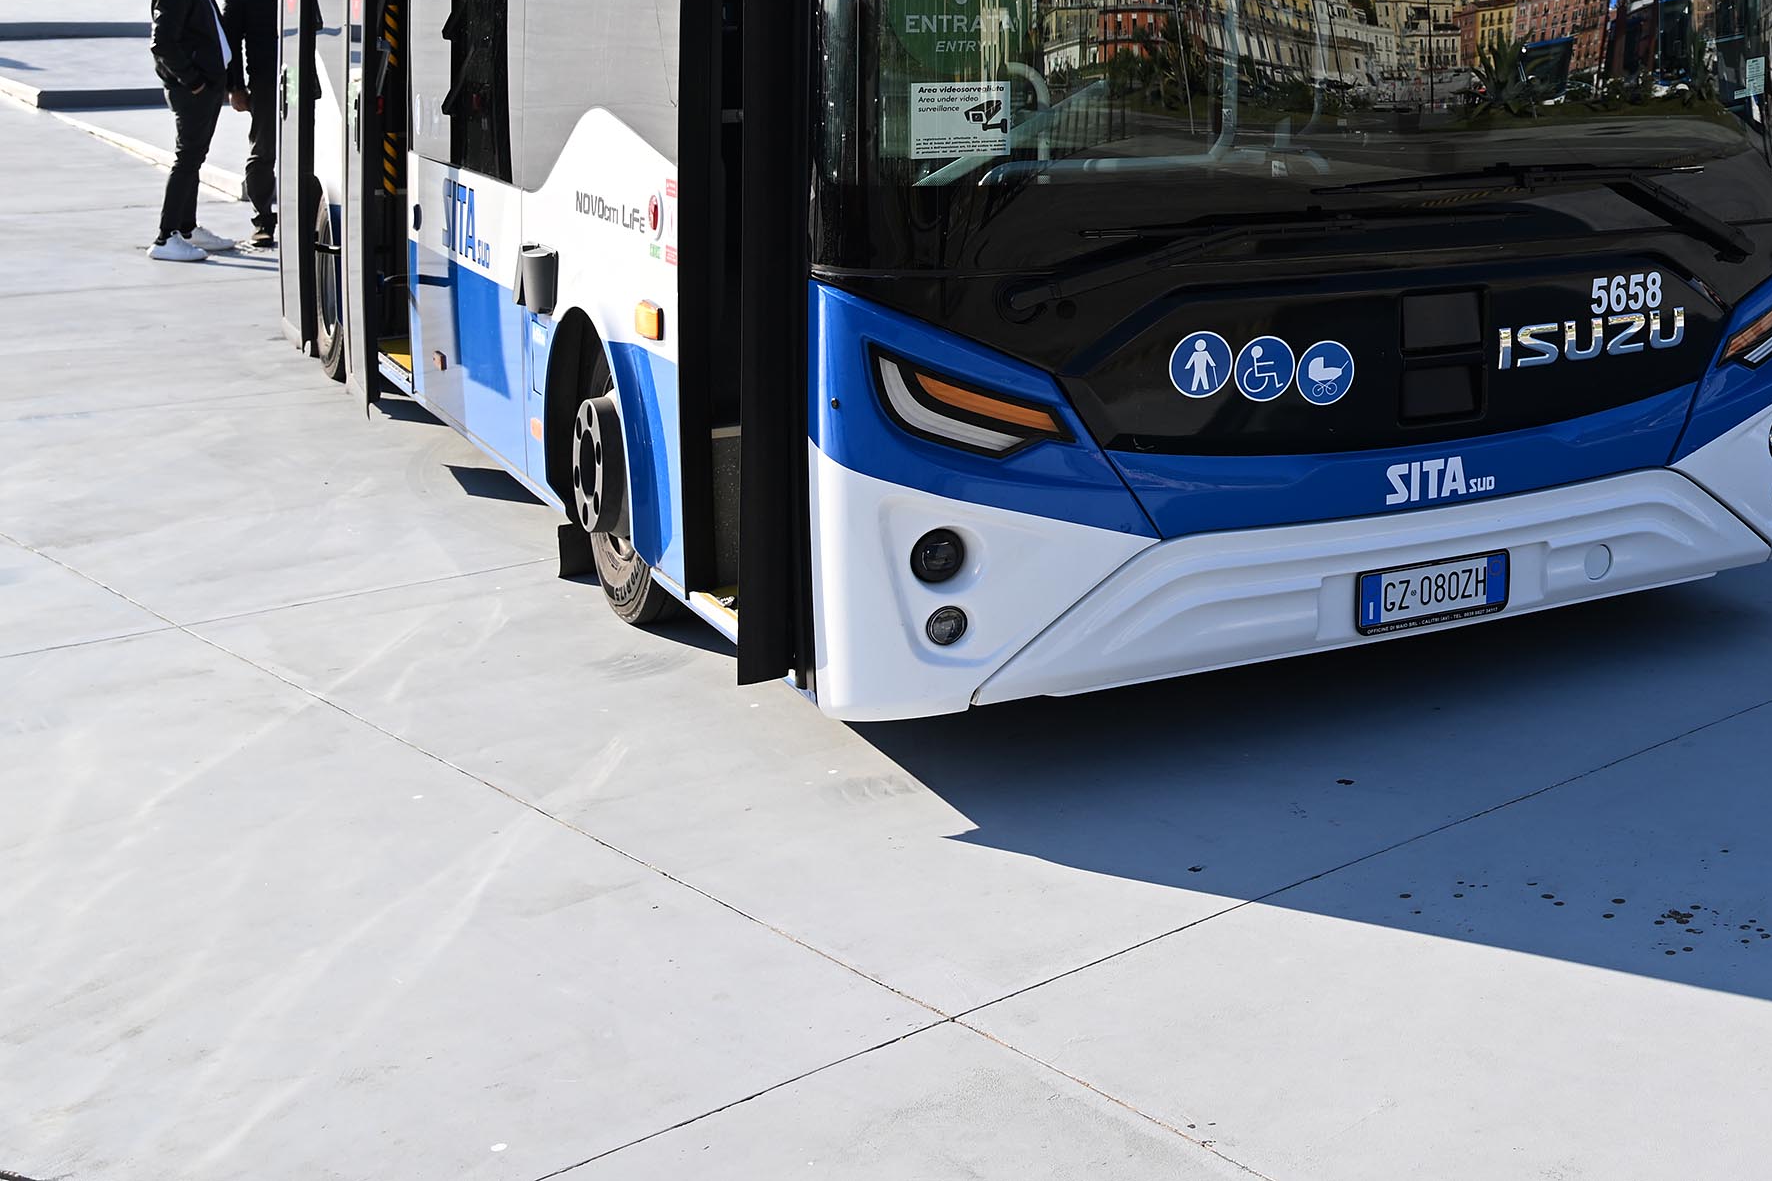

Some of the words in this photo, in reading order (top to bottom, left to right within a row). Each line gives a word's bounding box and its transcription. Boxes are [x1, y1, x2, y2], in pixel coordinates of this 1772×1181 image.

[905, 14, 1016, 33] ENTRATA
[936, 40, 986, 52] ENTRY
[918, 86, 938, 94] Area
[959, 94, 979, 102] video
[918, 105, 960, 113] surveillance
[441, 177, 477, 263] SITA
[1591, 271, 1662, 314] 5658
[1498, 306, 1685, 370] ISUZU
[1386, 455, 1467, 506] SITA
[1469, 475, 1496, 493] SUD
